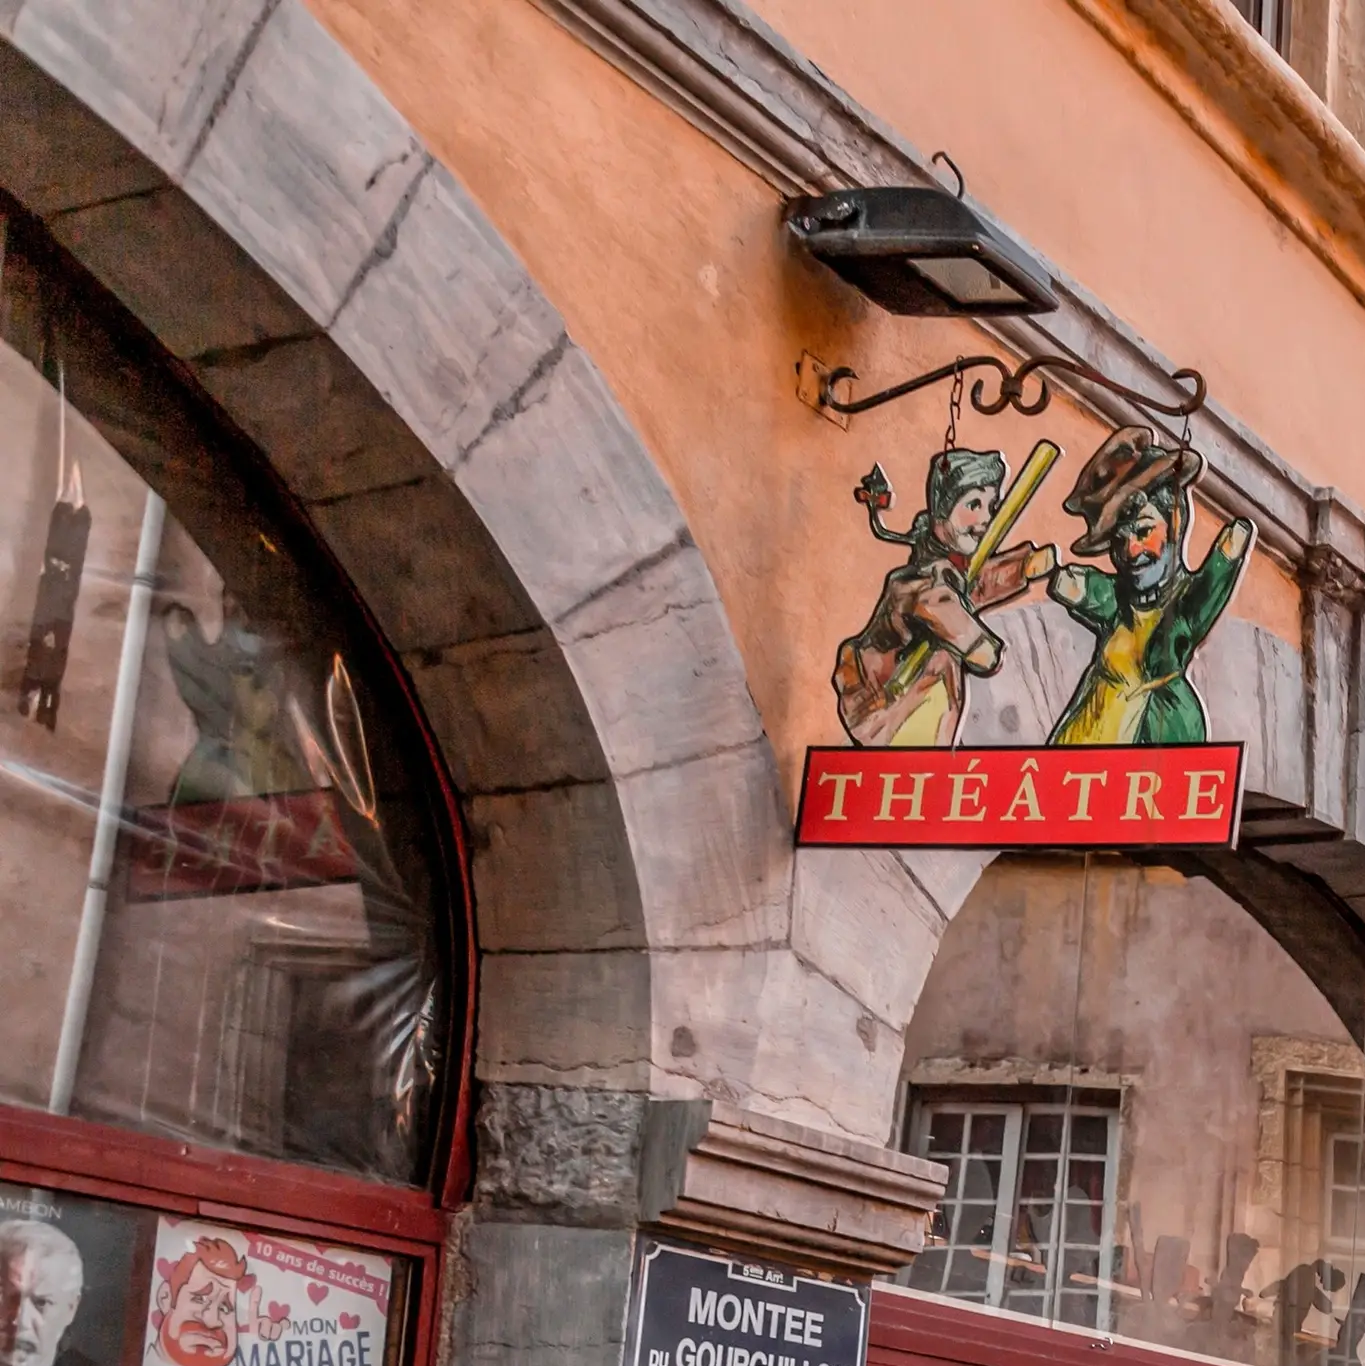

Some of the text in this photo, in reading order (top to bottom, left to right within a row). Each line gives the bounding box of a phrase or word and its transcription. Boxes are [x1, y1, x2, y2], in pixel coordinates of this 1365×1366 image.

[818, 758, 1226, 823] THÉÂTRE
[255, 1241, 273, 1257] 10
[275, 1250, 303, 1269] ans
[306, 1259, 325, 1275] de
[328, 1268, 375, 1293] succès
[292, 1317, 337, 1335] MON
[688, 1287, 825, 1348] MONTEE
